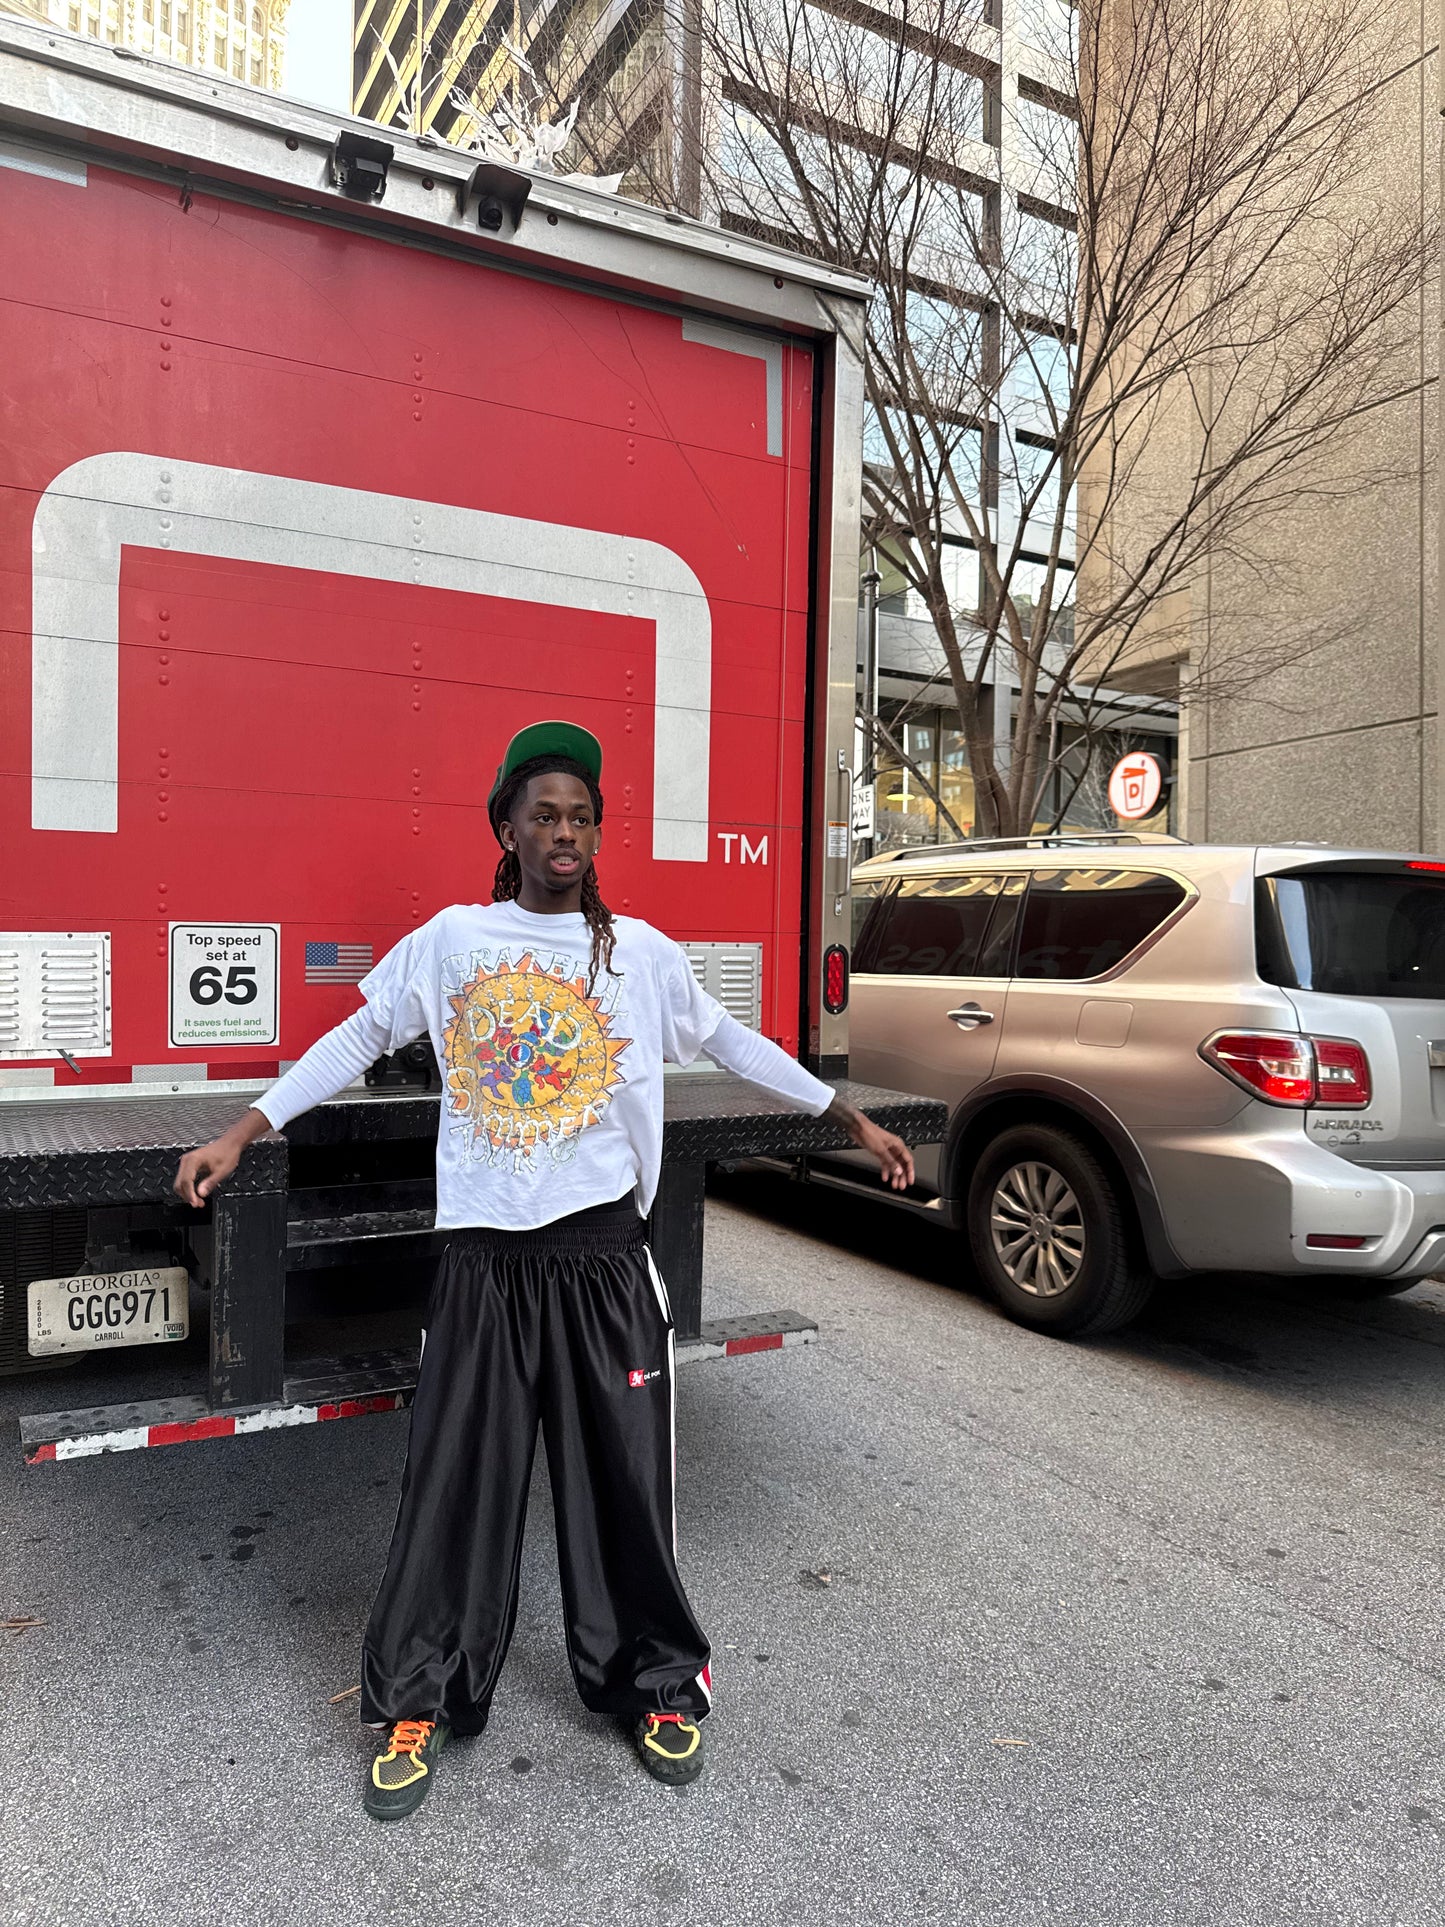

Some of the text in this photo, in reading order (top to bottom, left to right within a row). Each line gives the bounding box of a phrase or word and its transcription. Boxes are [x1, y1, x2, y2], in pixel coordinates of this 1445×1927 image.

[853, 791, 870, 805] ONE
[1129, 783, 1140, 798] D
[717, 833, 768, 865] TM
[186, 933, 261, 948] Top speed
[206, 950, 247, 961] set at
[189, 965, 258, 1006] 65
[441, 946, 628, 1017] GRATEFUL
[184, 1018, 262, 1027] It saves fuel and
[465, 998, 582, 1050] DEAD
[178, 1028, 270, 1038] reduces emissions.
[1313, 1118, 1384, 1131] ARMADA
[67, 1272, 152, 1294] GEORGIA
[67, 1287, 170, 1332] GGG971
[95, 1331, 125, 1342] CARROLL
